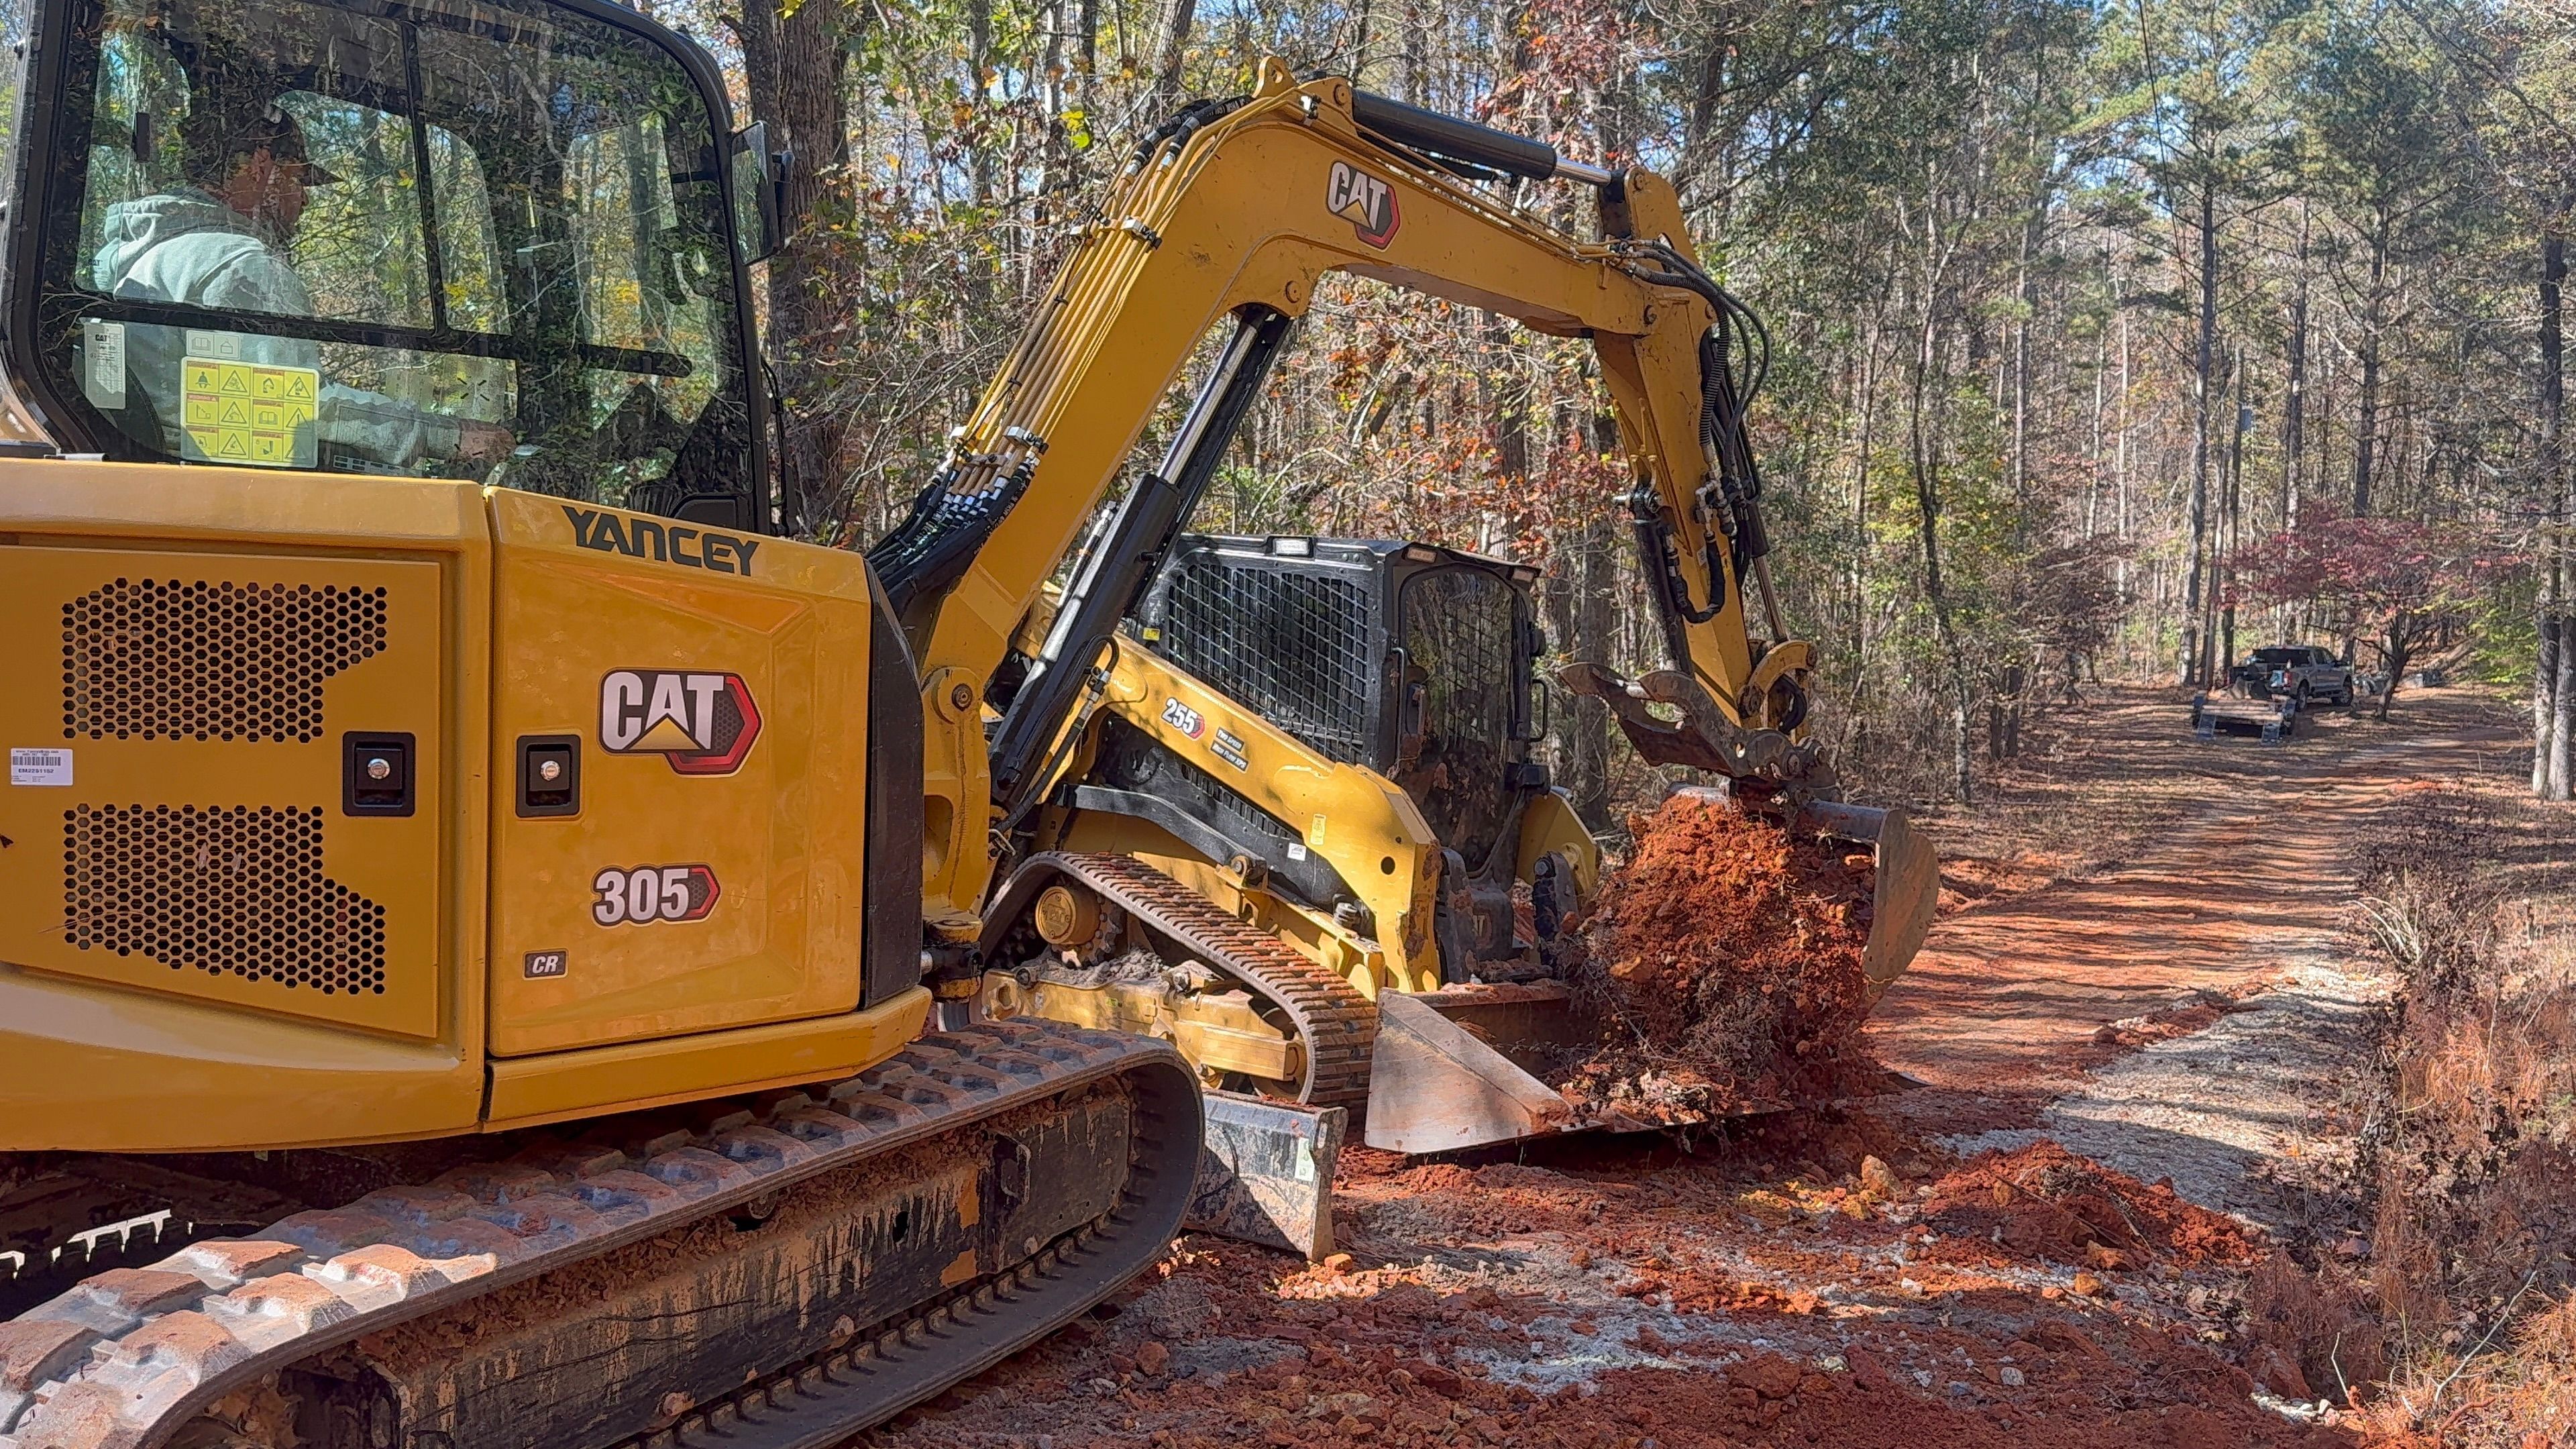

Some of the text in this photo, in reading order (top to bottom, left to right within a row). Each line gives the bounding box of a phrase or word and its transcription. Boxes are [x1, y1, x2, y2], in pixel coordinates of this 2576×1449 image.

[1328, 161, 1387, 231] CAT
[561, 504, 761, 577] YANCEY
[602, 671, 724, 751] CAT
[1162, 697, 1199, 734] 255
[595, 867, 690, 924] 305
[532, 955, 559, 973] CR
